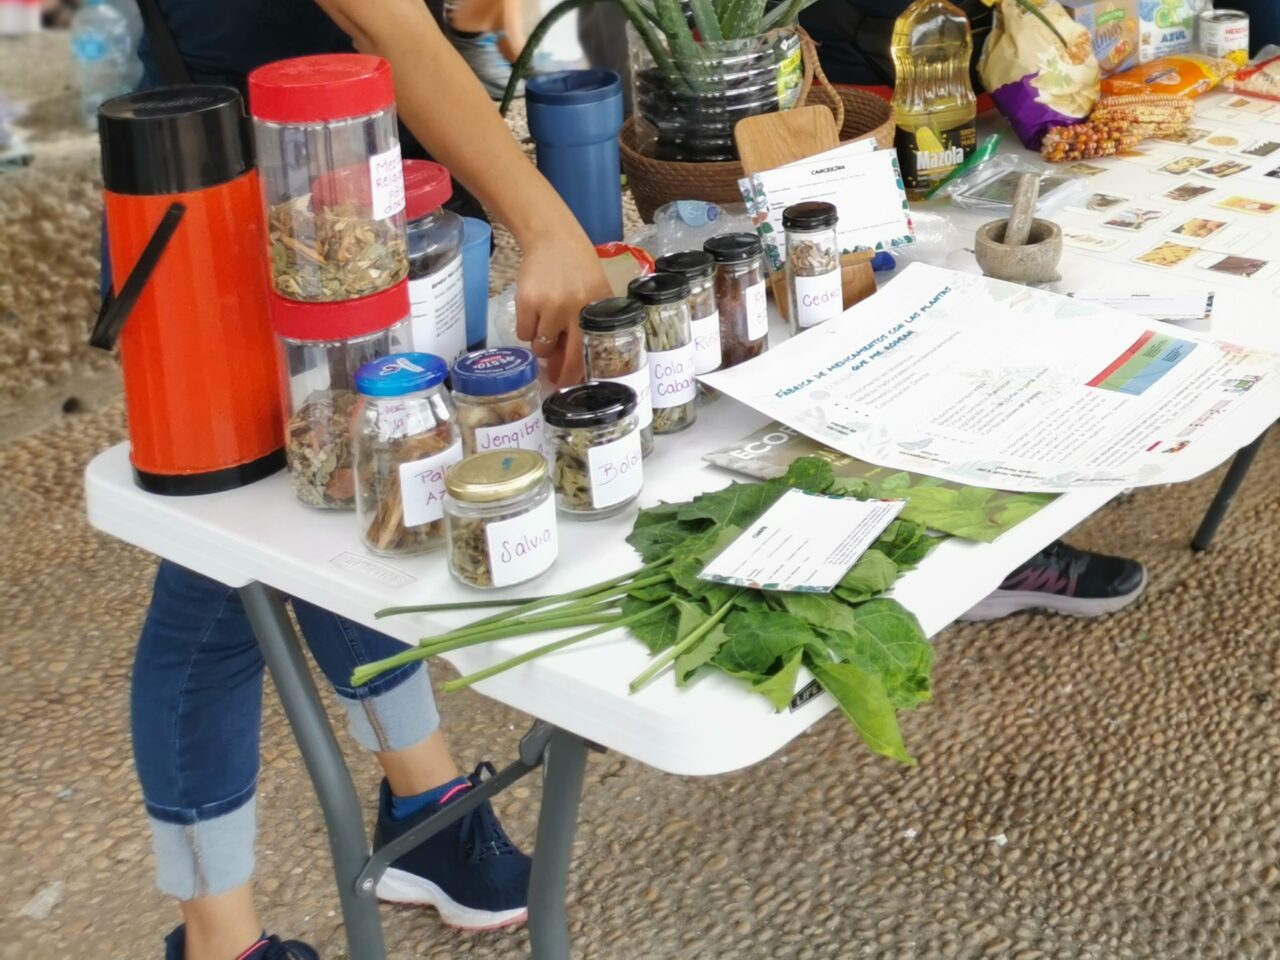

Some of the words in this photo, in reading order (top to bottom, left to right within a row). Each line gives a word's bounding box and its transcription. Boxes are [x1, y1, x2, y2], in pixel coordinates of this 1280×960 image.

[917, 146, 964, 170] Mazola
[655, 361, 683, 380] Cola
[501, 527, 551, 565] Salvia
[796, 683, 820, 707] LIFE
